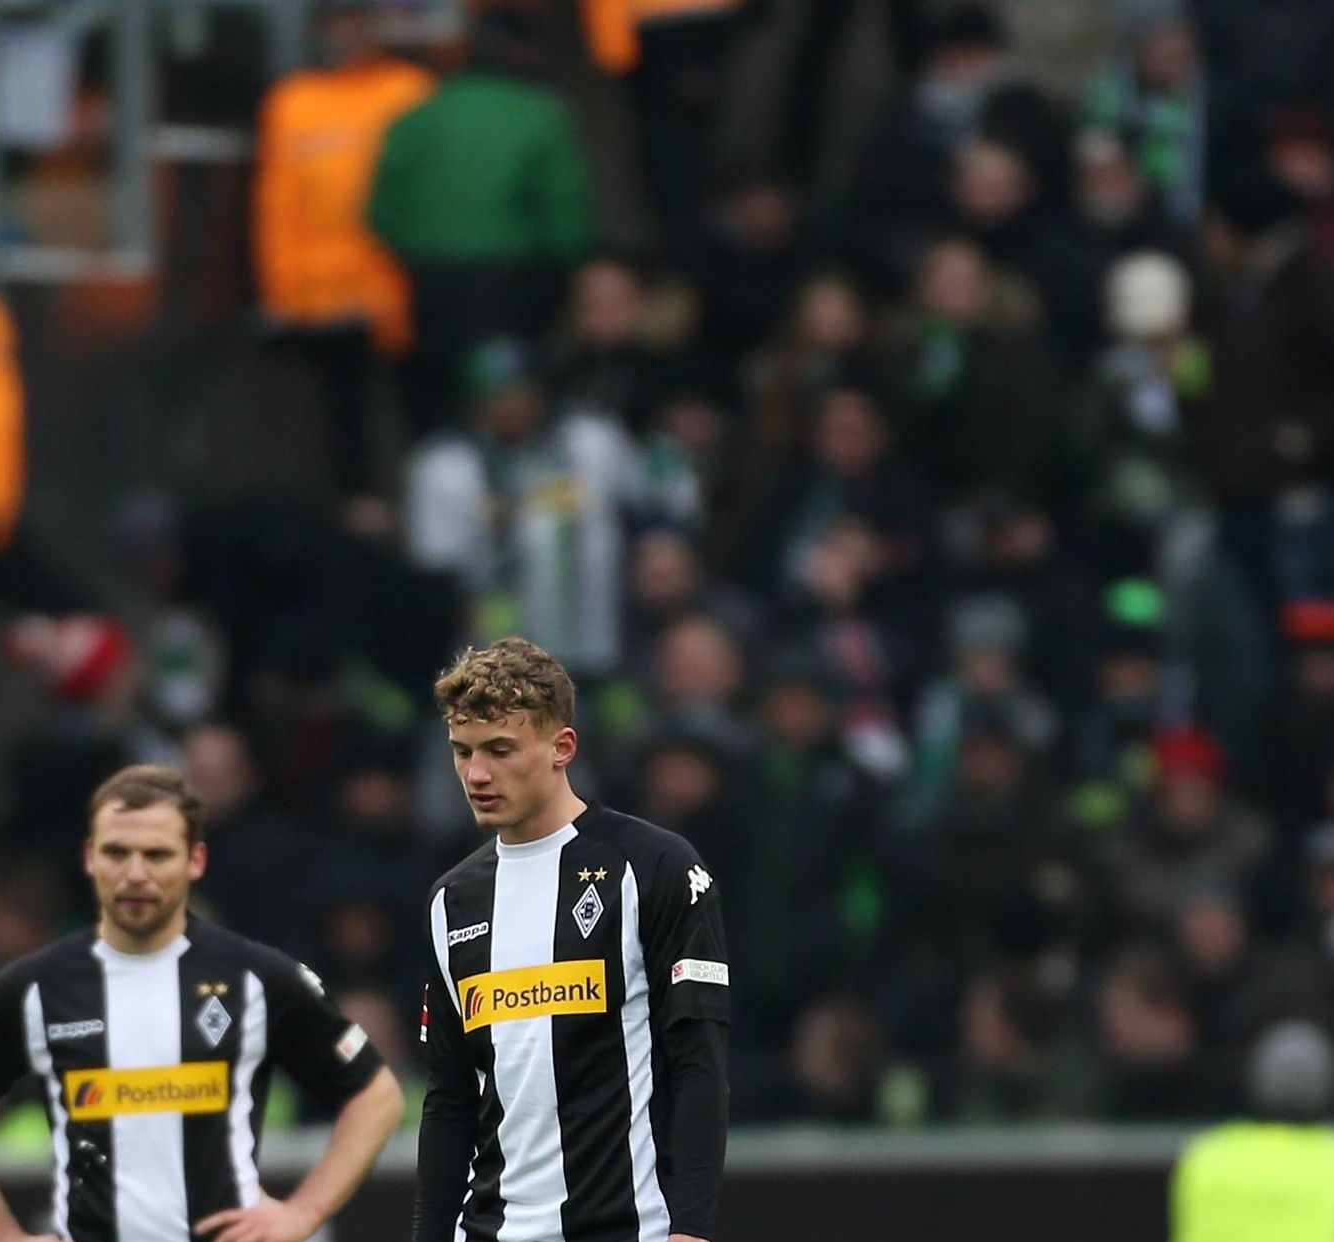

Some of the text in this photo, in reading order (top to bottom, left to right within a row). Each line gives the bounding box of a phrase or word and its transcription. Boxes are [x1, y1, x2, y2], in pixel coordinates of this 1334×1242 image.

[449, 923, 488, 945] Kappa
[493, 976, 600, 1010] Postbank
[116, 1077, 222, 1104] Postbank
